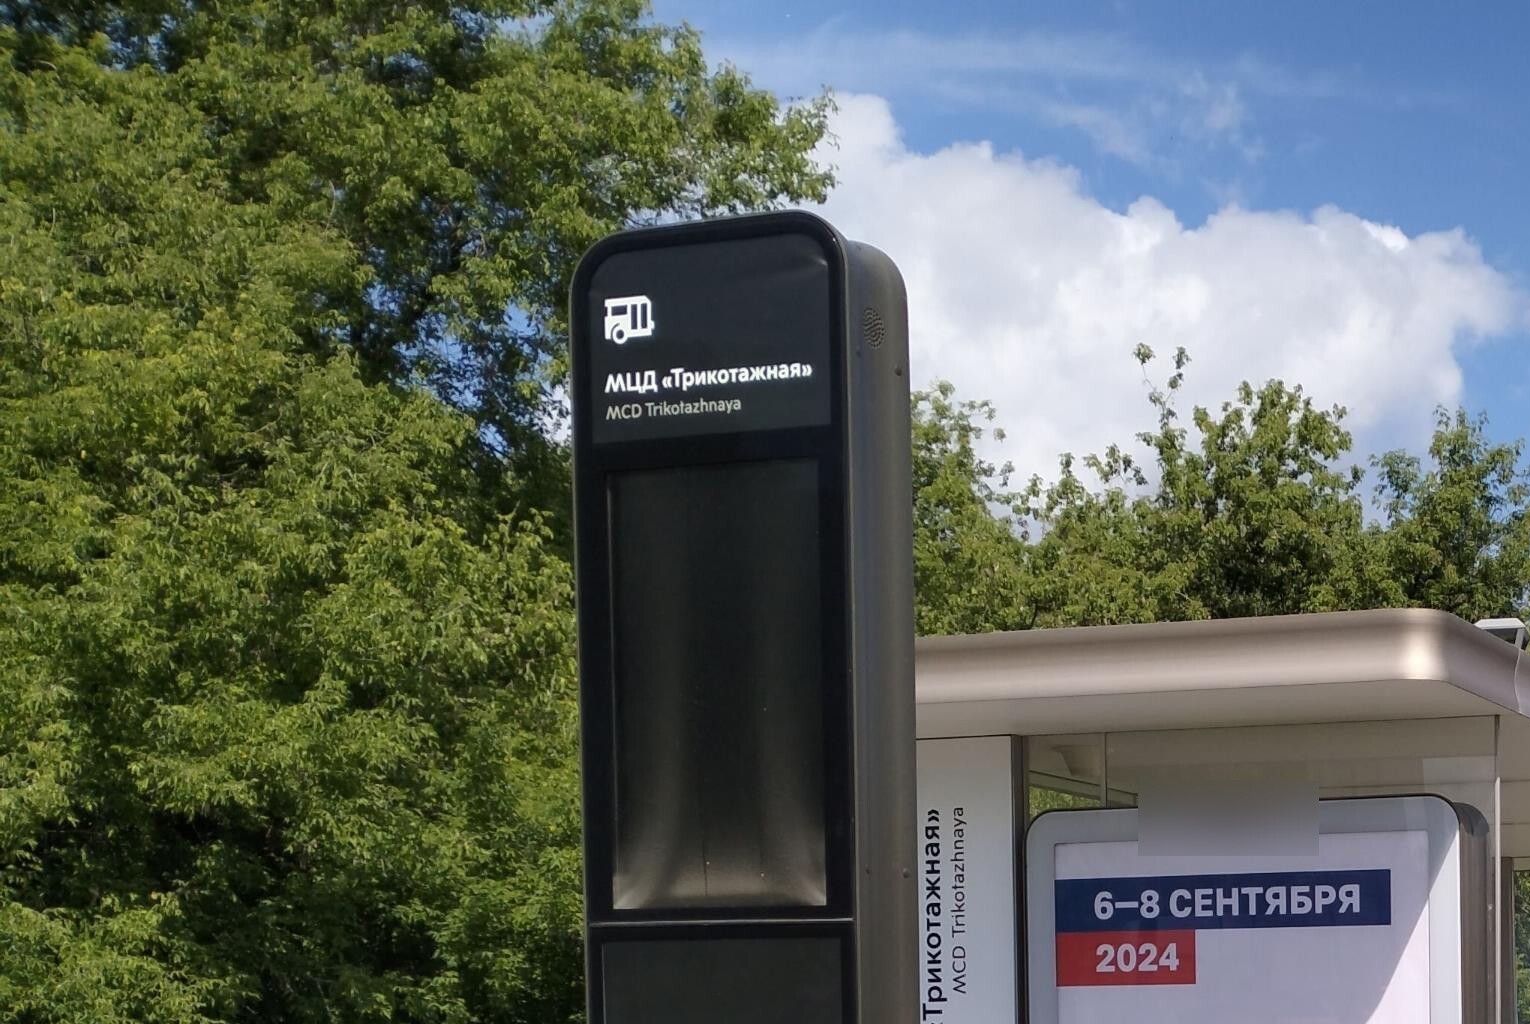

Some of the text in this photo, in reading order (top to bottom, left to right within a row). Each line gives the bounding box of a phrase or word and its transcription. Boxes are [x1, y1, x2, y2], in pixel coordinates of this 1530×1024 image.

[605, 362, 813, 394] МЦД «Трикотажная»
[605, 397, 742, 421] MCD Trikotazhnaya
[951, 806, 967, 994] MCD Trikotazhnaya
[1169, 884, 1361, 918] СЕНТЯБРЯ
[1095, 943, 1179, 974] 2024
